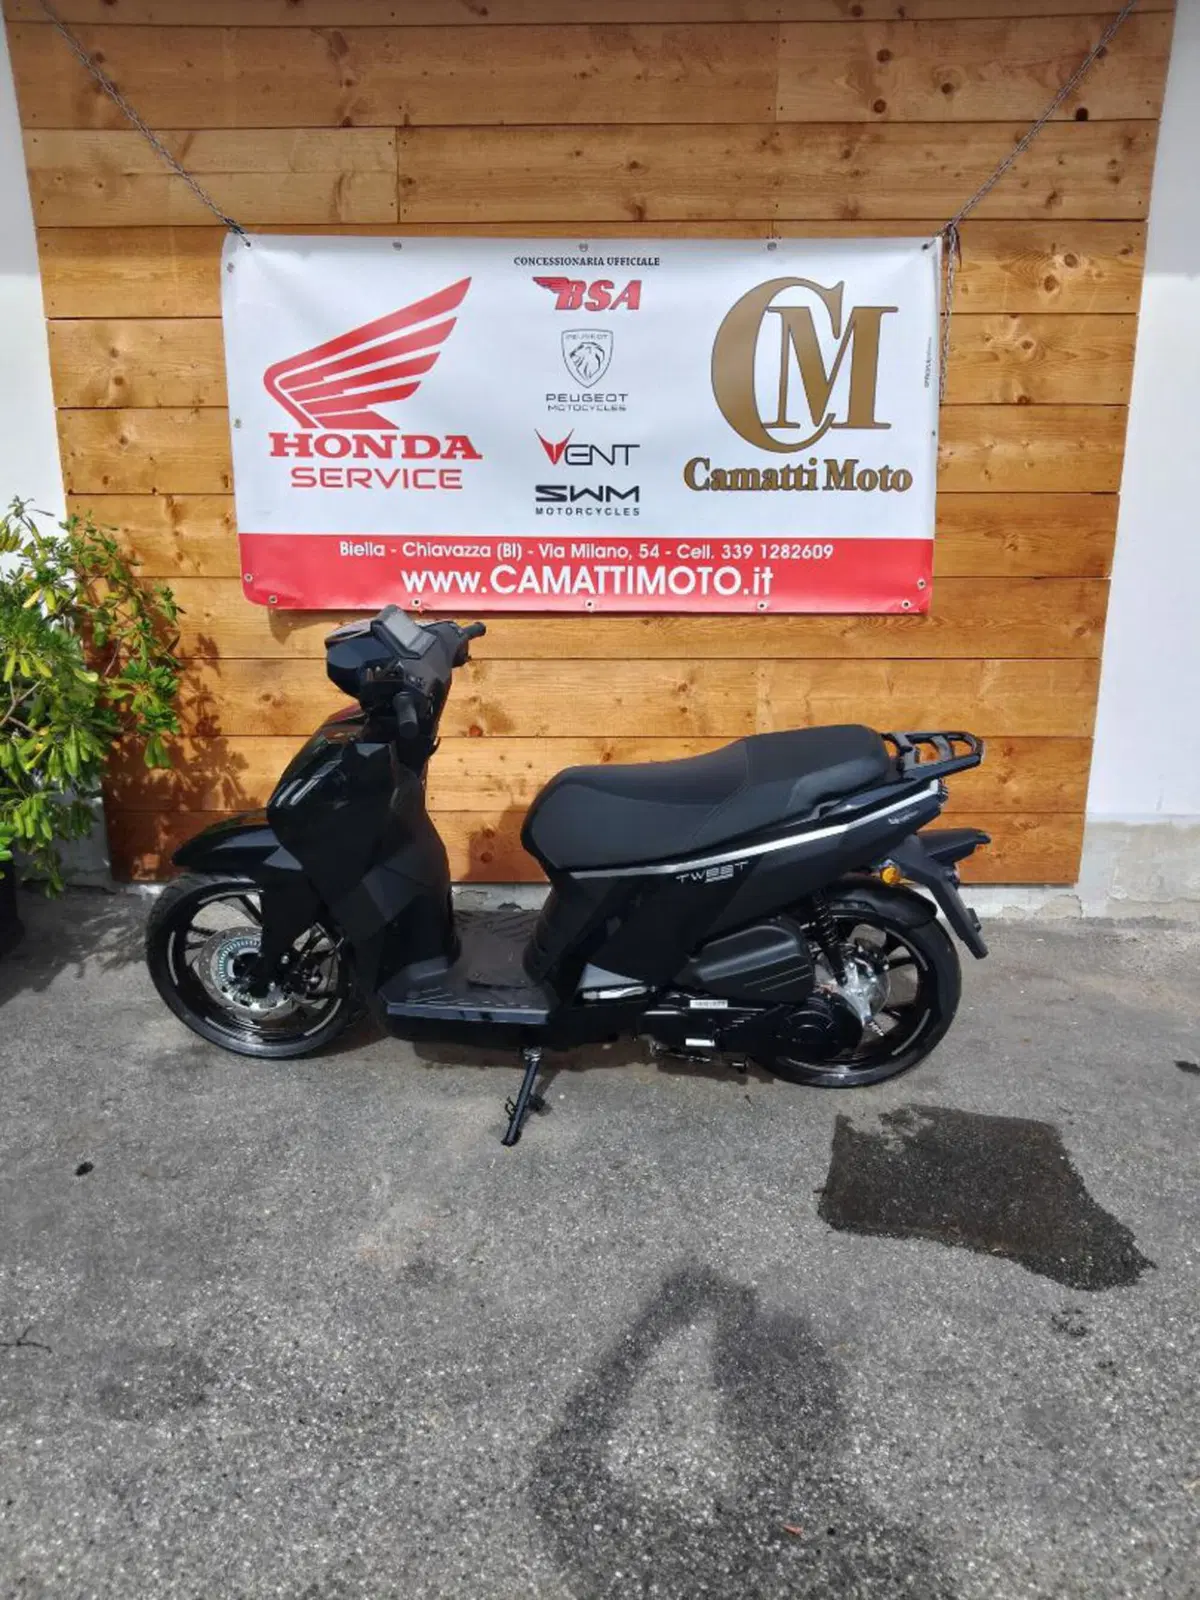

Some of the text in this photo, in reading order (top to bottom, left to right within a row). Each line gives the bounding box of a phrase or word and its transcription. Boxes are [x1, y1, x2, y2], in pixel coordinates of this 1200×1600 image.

[513, 257, 661, 267] CONCESSIONARIA UFFICIALE
[553, 278, 643, 312] BSA
[545, 393, 629, 403] PEUGEOT
[268, 432, 483, 460] HONDA
[534, 428, 641, 466] VENT
[290, 466, 463, 490] SERVICE
[683, 457, 914, 493] Camatti Moto
[535, 485, 640, 503] SWM
[535, 507, 641, 517] MOTORCYCLES
[339, 541, 386, 557] Biella
[402, 541, 492, 558] Chiavazza
[497, 543, 523, 561] (BI)
[539, 543, 565, 559] Via
[571, 543, 633, 561] Milano,
[638, 544, 660, 559] 54
[676, 544, 715, 560] Cell.
[721, 544, 754, 560] 339
[760, 544, 834, 560] 1282609
[400, 564, 774, 596] www.CAMATTIMOTO.it
